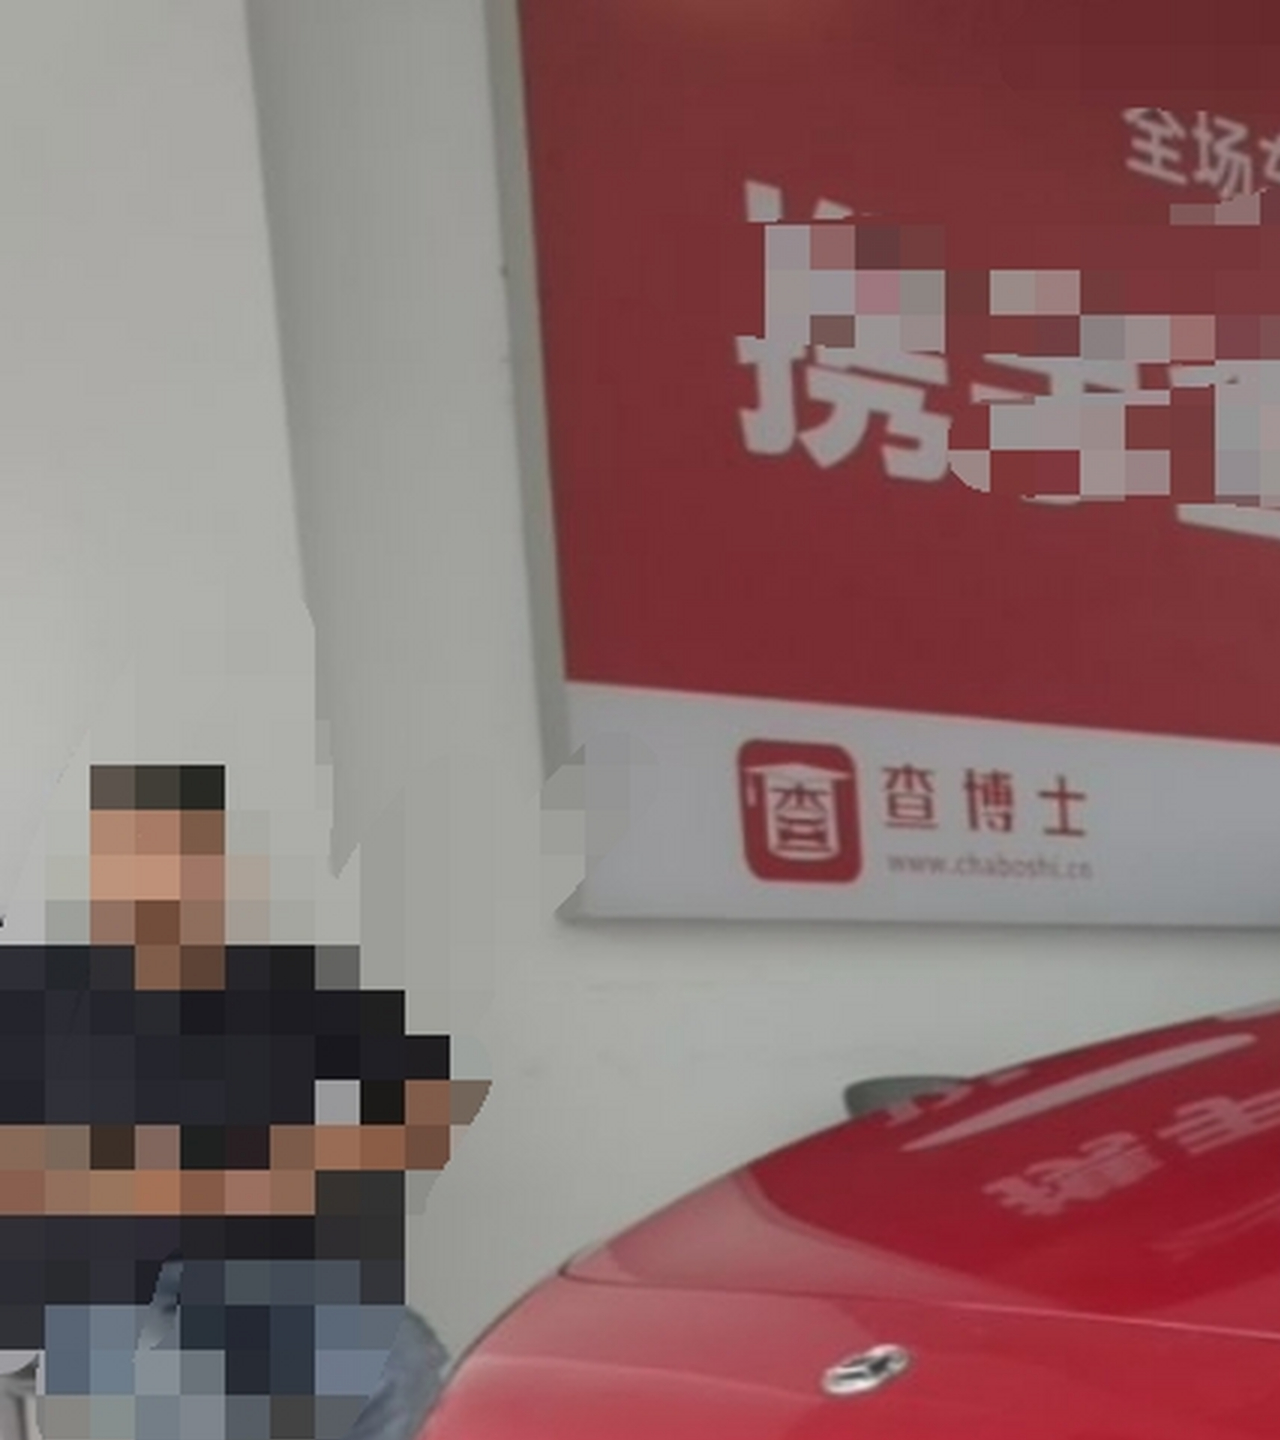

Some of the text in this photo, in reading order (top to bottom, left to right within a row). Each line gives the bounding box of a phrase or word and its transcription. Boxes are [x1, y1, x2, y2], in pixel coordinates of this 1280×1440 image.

[880, 763, 1088, 838] 查博士
[887, 852, 1095, 881] www.chaboshi.cn
